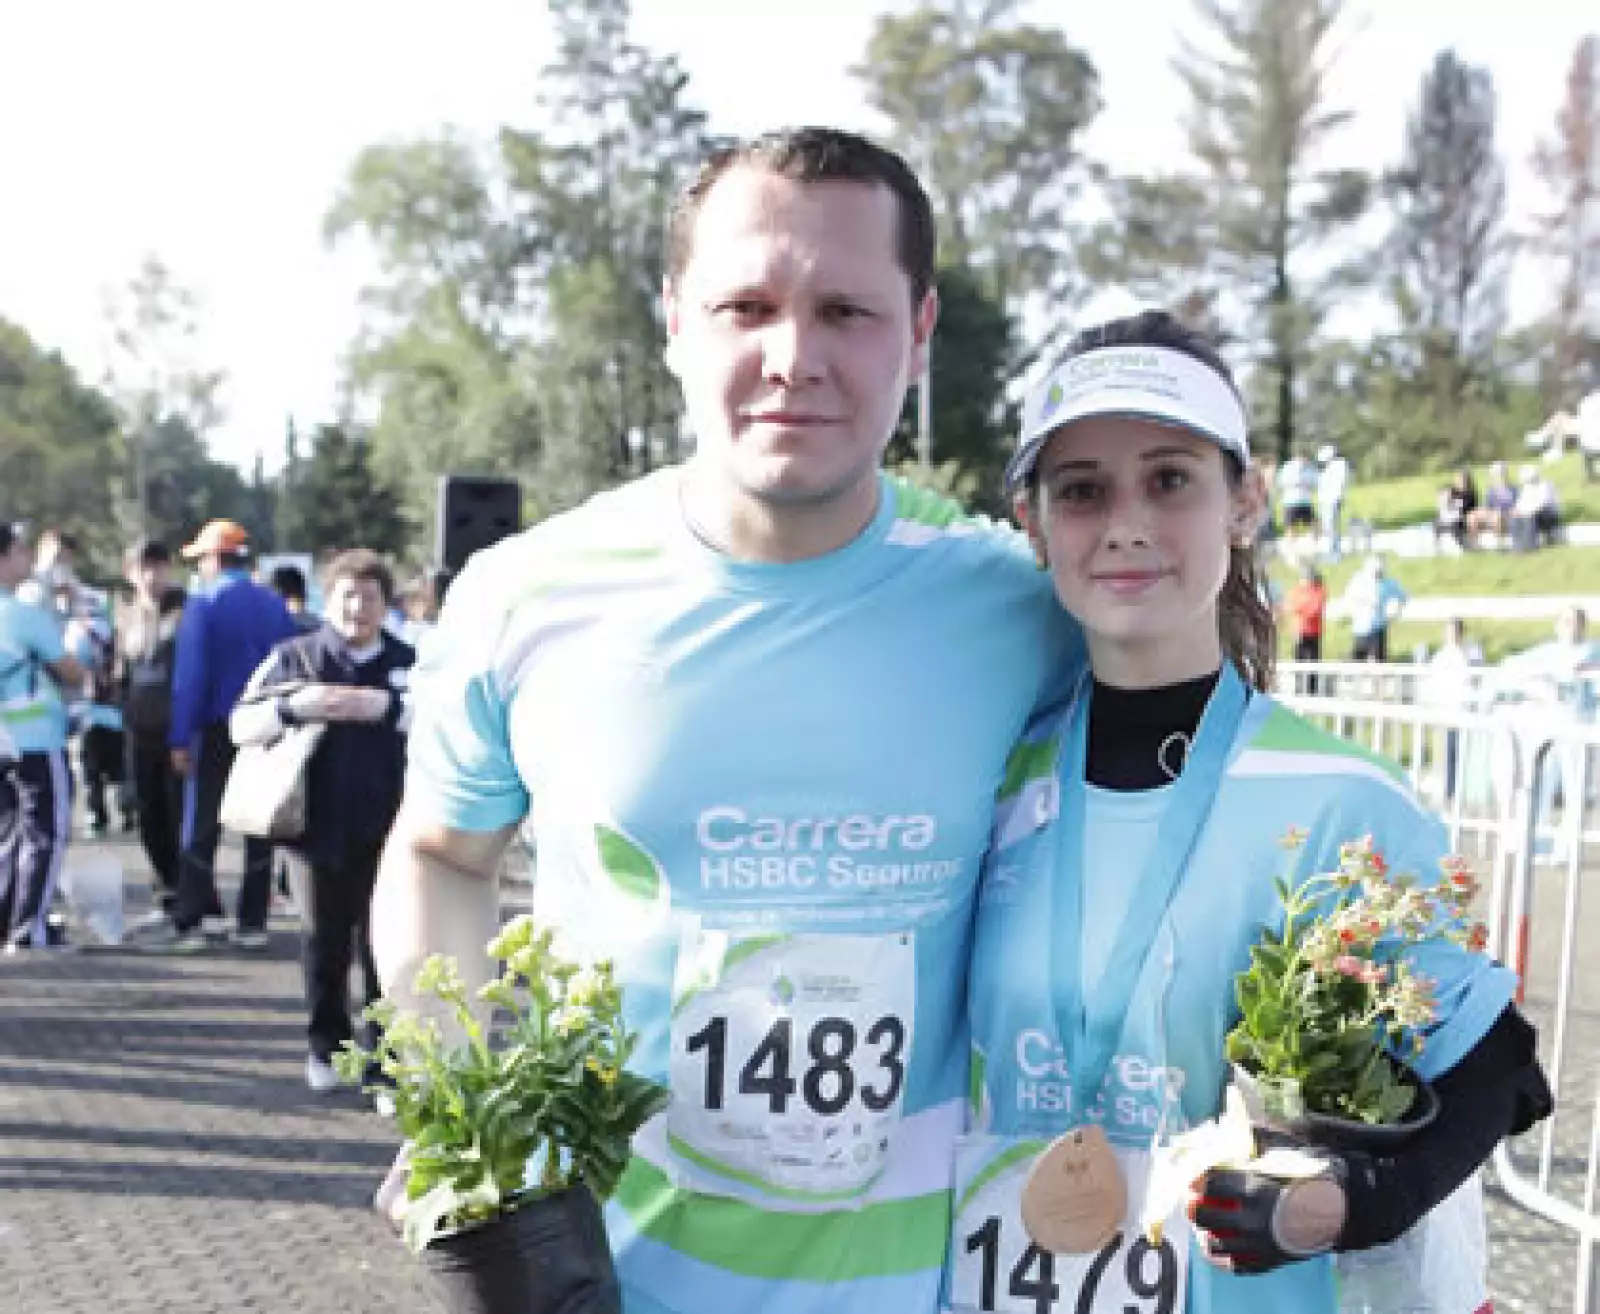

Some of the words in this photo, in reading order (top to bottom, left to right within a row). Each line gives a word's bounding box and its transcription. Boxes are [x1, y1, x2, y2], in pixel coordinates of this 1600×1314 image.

[697, 806, 936, 851] Carrera
[699, 855, 816, 889] HSBC
[685, 1015, 906, 1115] 1483
